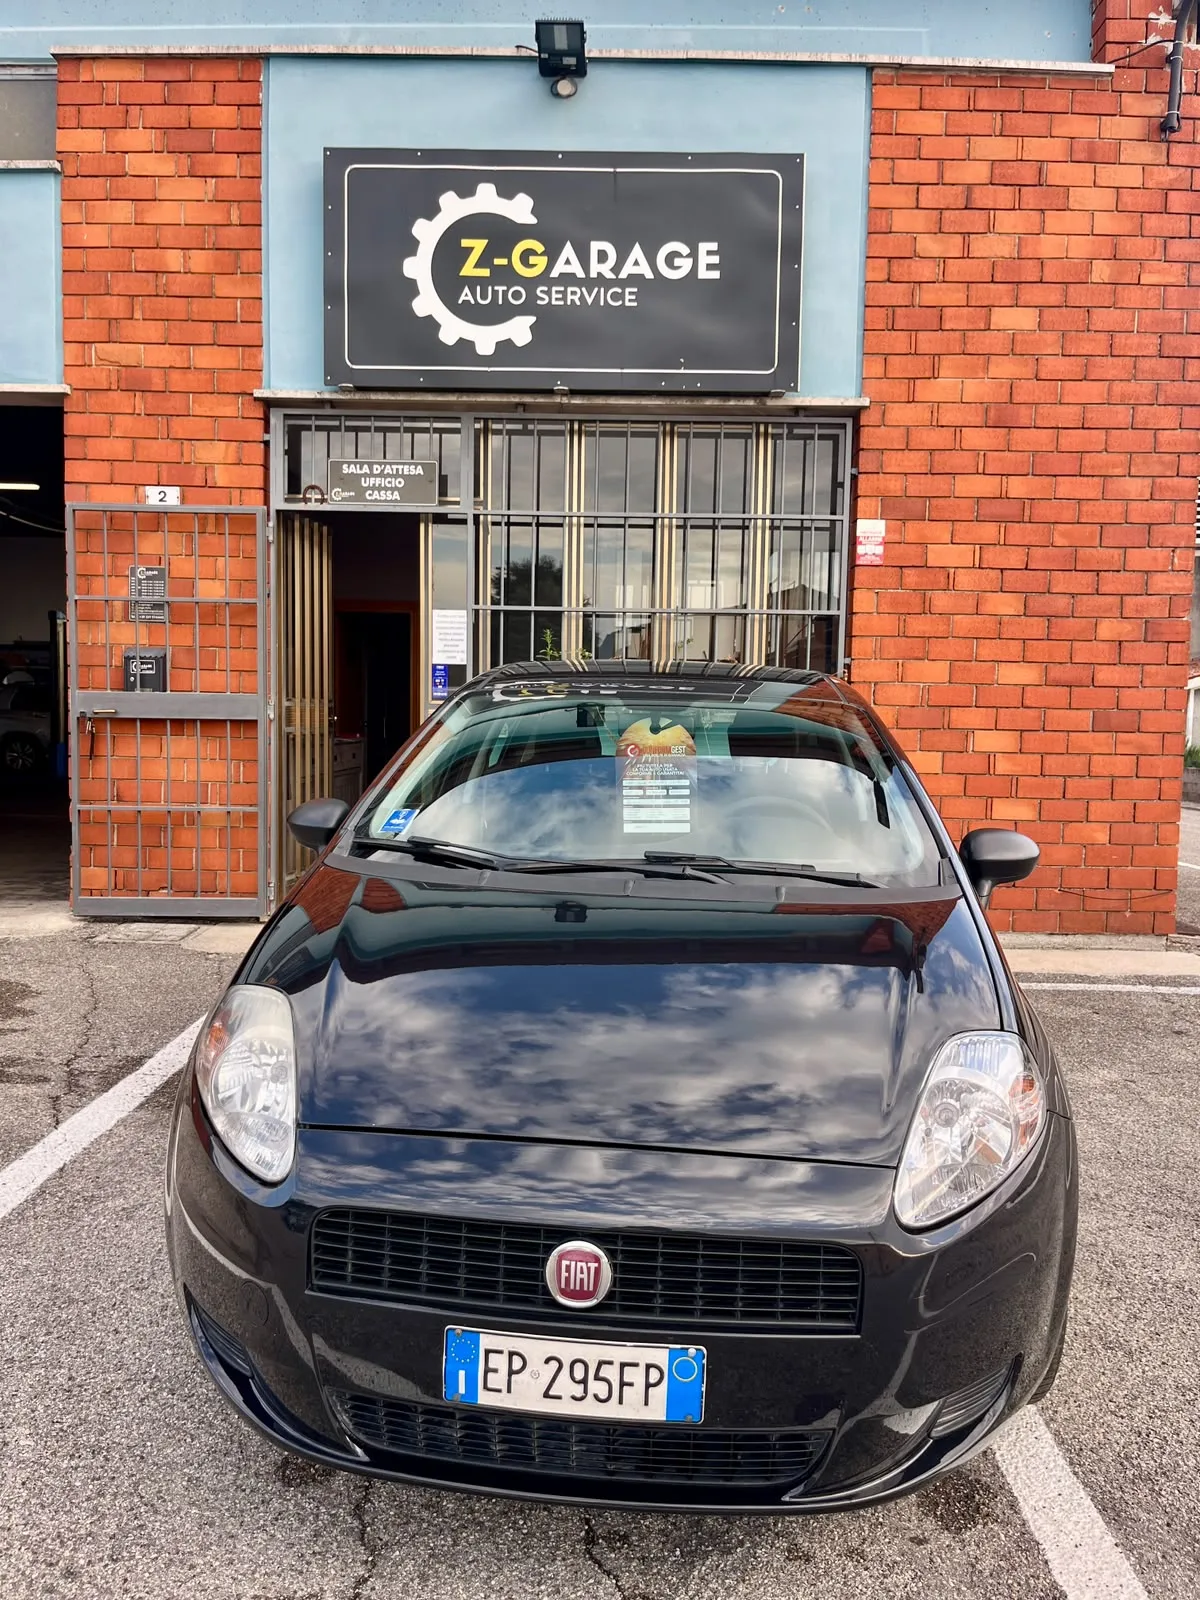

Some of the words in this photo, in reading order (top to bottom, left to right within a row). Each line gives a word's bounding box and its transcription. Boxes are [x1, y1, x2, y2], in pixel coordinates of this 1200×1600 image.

[459, 238, 721, 280] Z-GARAGE
[458, 285, 526, 305] AUTO
[536, 286, 638, 307] SERVICE
[342, 464, 370, 474] SALA
[373, 464, 424, 475] D'ATTESA
[361, 477, 405, 488] UFFICIO
[158, 490, 167, 502] 2
[365, 490, 401, 500] CASSA
[560, 1259, 599, 1291] FIAT
[483, 1348, 527, 1394] EP
[542, 1355, 665, 1406] 295FP
